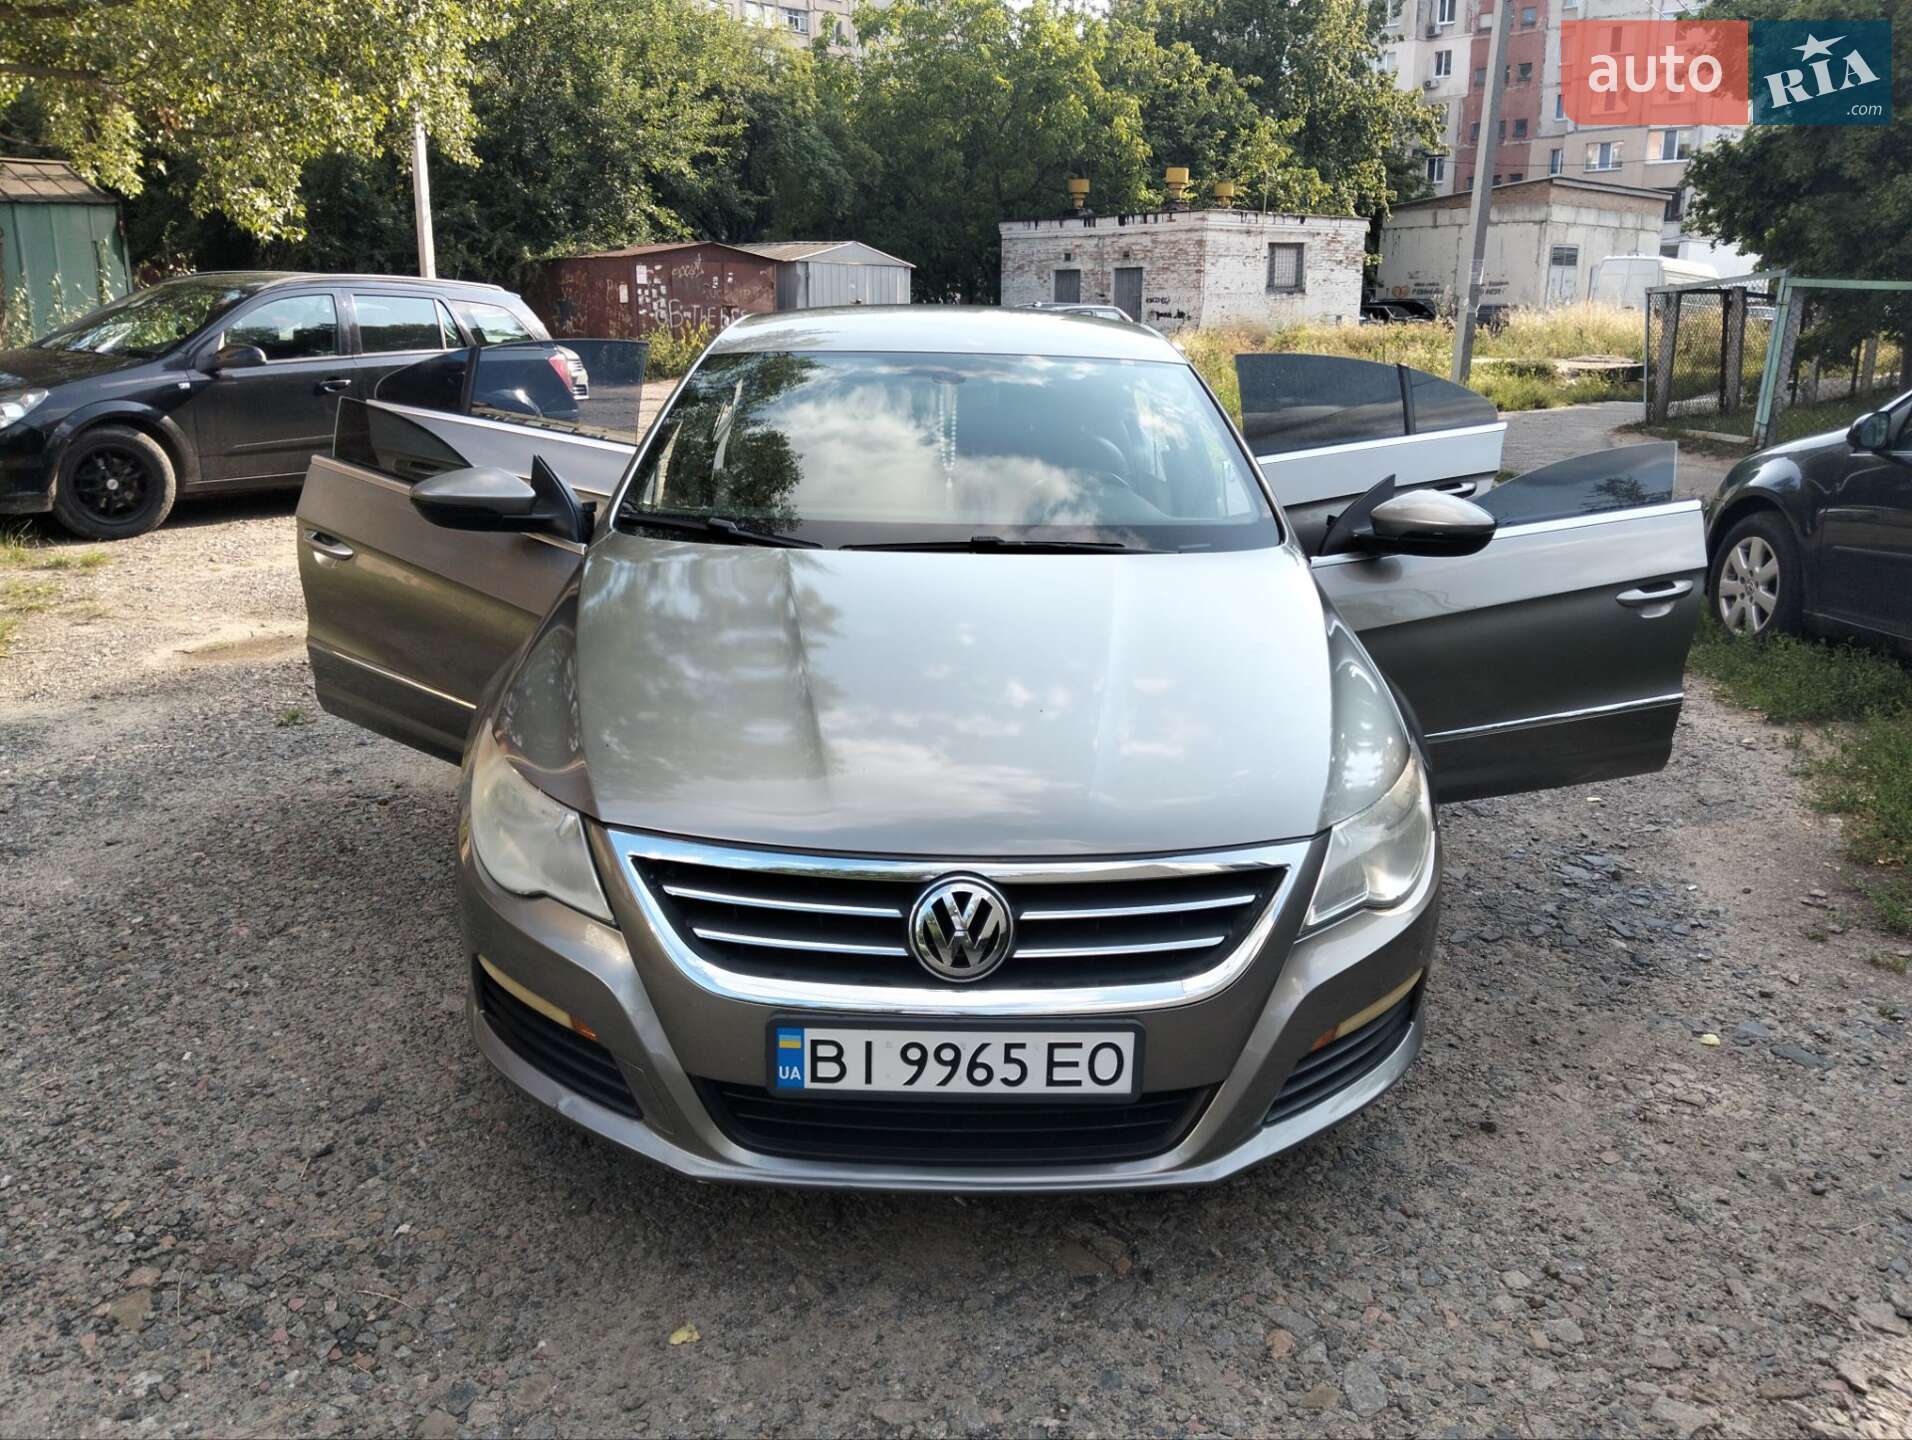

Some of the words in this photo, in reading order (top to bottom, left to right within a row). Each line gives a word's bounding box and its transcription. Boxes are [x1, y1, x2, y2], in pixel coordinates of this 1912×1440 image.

[779, 1065, 801, 1081] UA
[810, 1039, 873, 1085] BI
[899, 1041, 1028, 1087] 9965
[1045, 1042, 1124, 1087] EO
